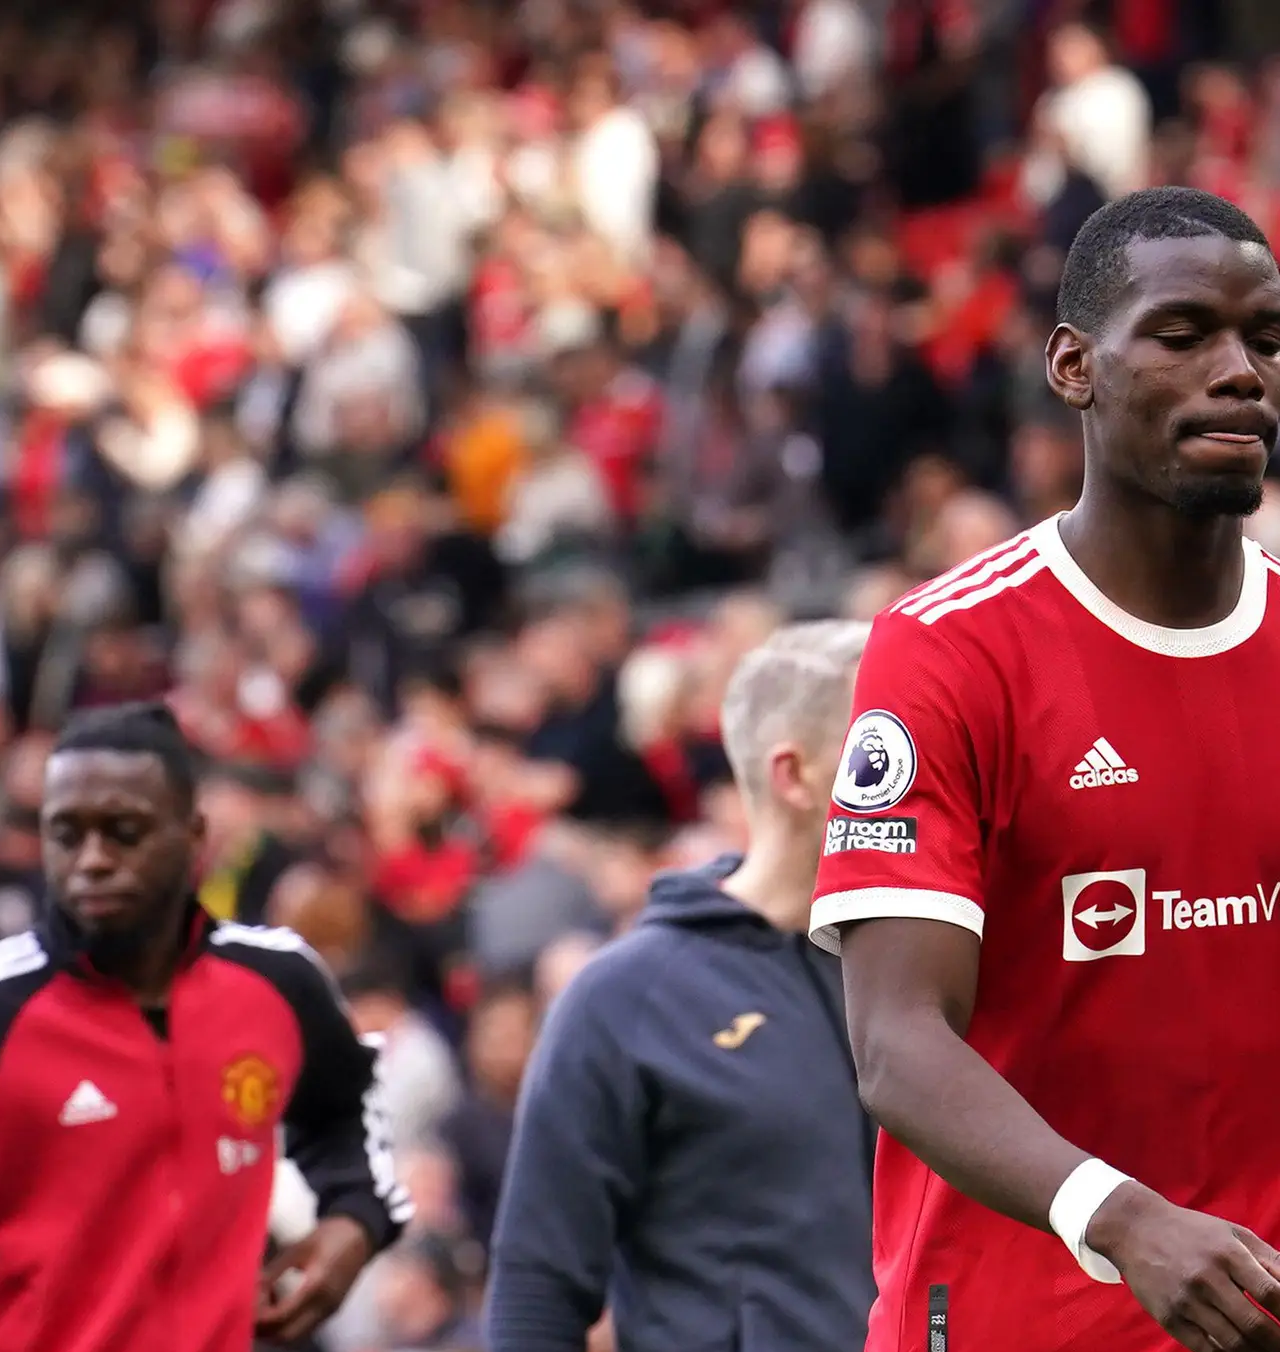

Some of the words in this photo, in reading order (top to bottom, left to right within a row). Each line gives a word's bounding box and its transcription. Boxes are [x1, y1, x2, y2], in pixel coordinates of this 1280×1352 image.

[861, 787, 891, 802] Premier
[889, 758, 905, 789] League
[1069, 767, 1140, 790] adidas
[826, 818, 847, 839] No
[849, 820, 907, 838] room
[847, 836, 916, 854] racism
